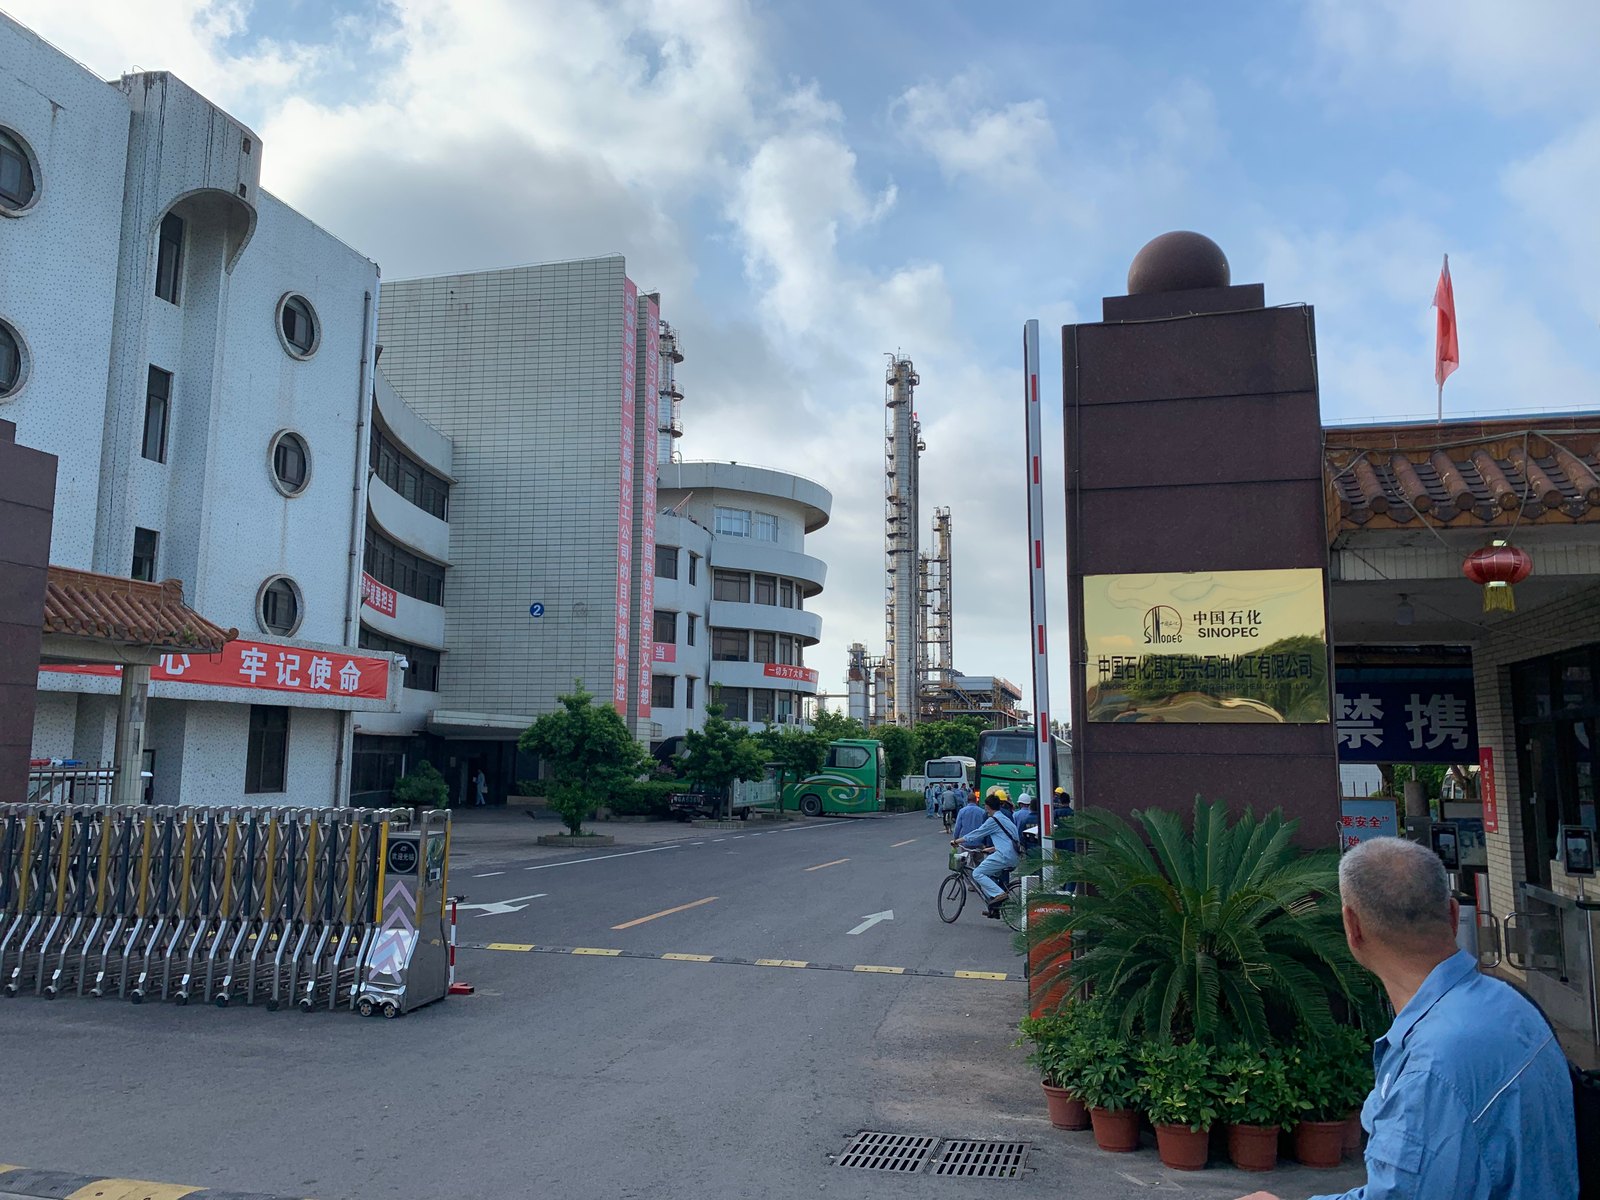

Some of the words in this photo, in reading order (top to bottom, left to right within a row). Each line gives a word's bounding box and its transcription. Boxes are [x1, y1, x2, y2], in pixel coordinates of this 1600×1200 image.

[533, 604, 541, 616] 2
[1193, 609, 1262, 626] 中国石化
[1197, 626, 1259, 639] SINOPEC
[655, 645, 664, 659] 当
[239, 647, 362, 693] 牢记使命
[1099, 653, 1312, 681] 中国石化湛江东兴石油化工有限公司
[1336, 693, 1469, 750] 禁携
